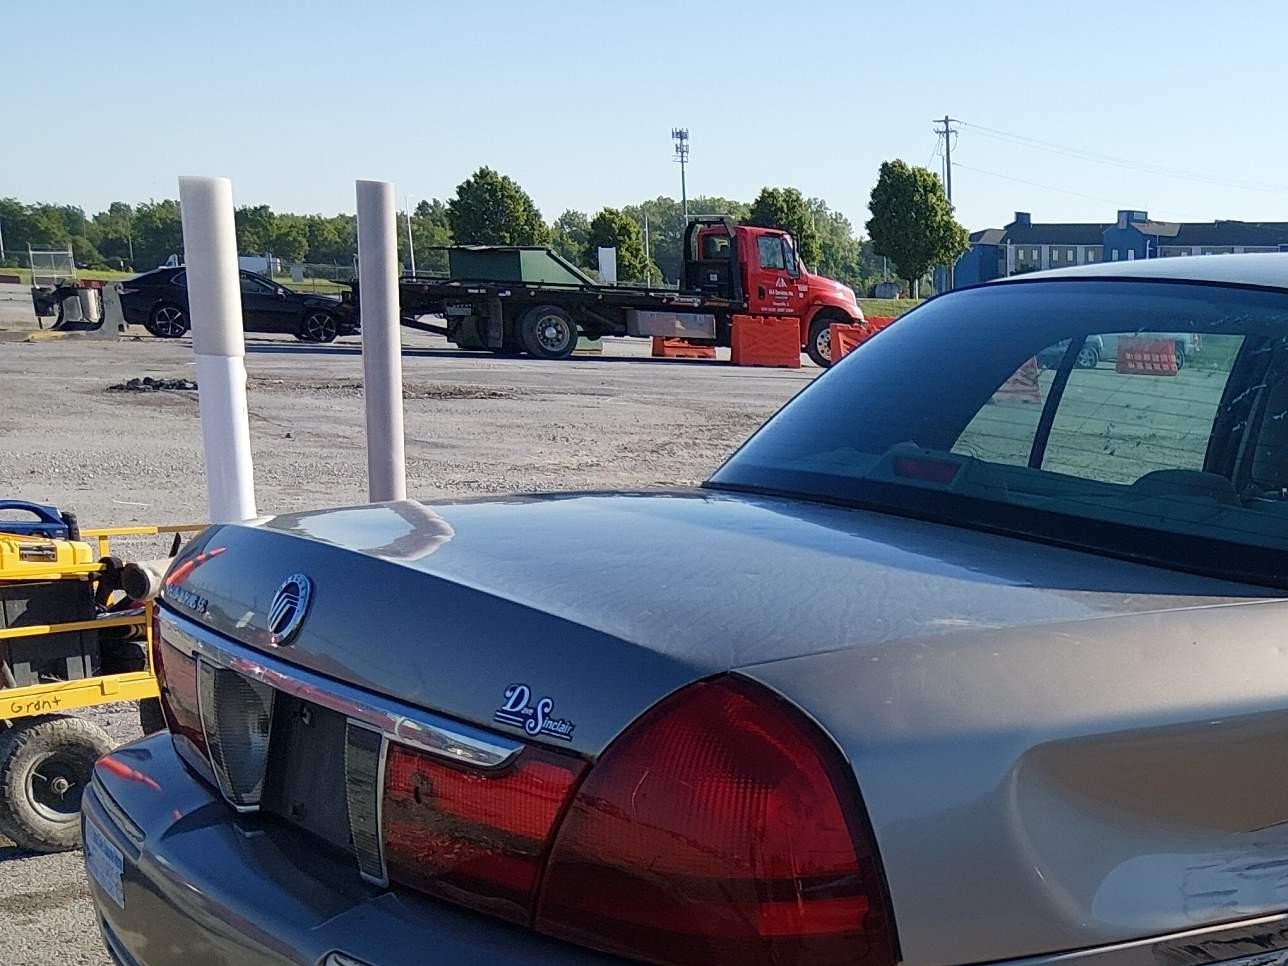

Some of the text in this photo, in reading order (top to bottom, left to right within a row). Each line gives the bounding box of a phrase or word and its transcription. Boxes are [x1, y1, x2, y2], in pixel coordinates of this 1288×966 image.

[11, 696, 61, 713] Grant
[501, 685, 534, 715] Dave
[525, 698, 573, 735] Sinclair
